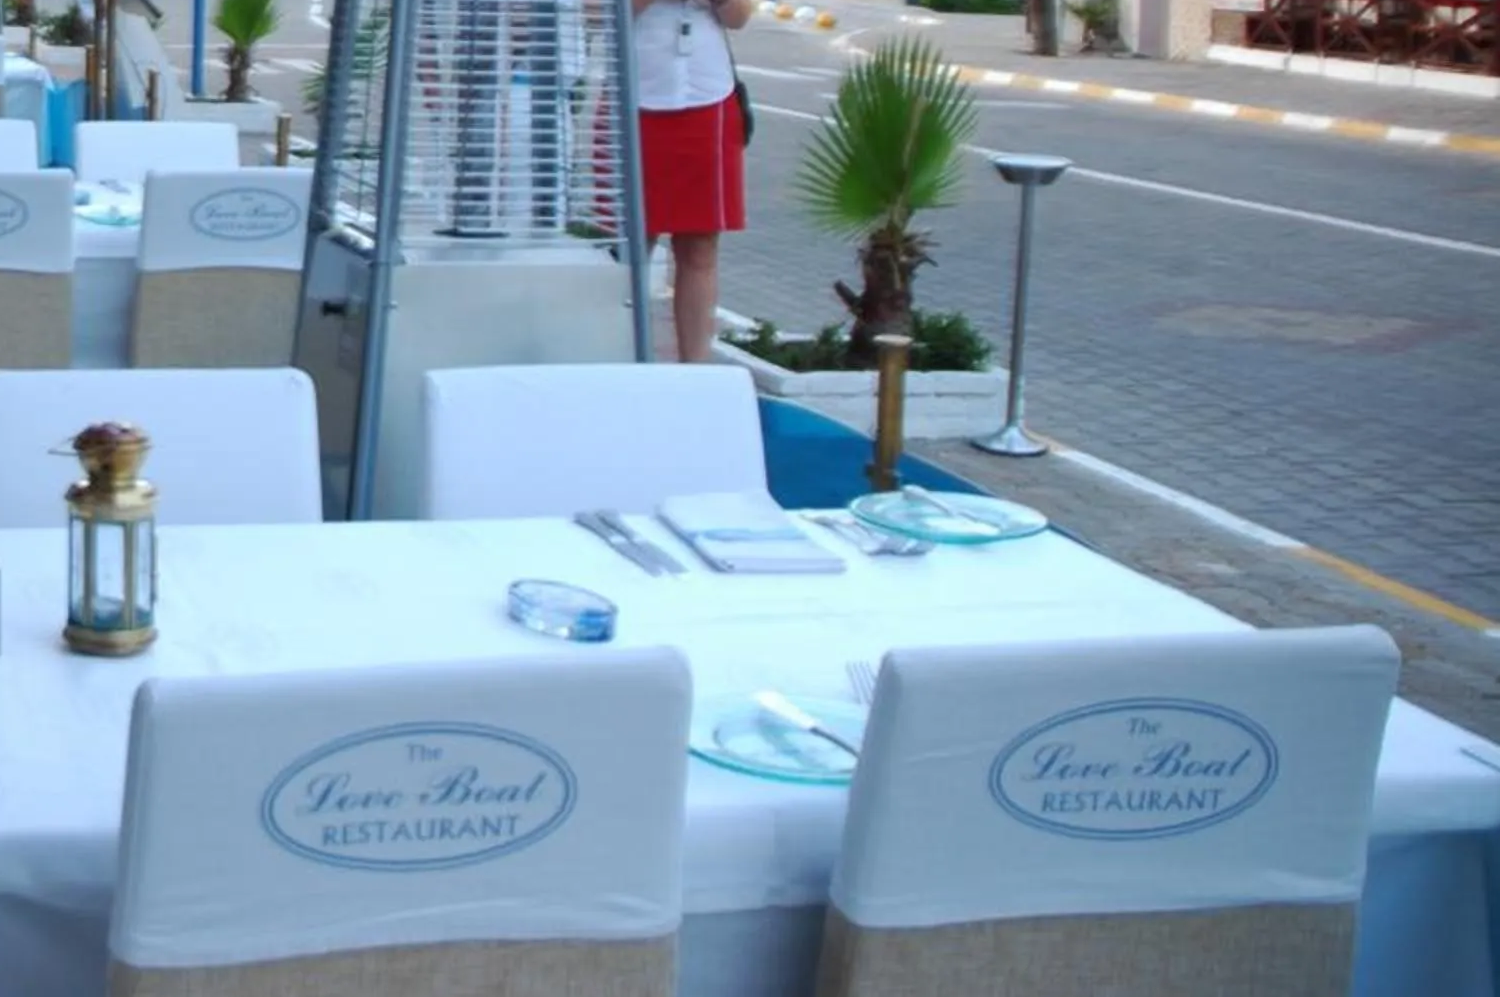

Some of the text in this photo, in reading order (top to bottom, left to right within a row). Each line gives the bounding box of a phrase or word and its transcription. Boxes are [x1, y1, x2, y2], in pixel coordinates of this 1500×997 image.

[1126, 717, 1162, 737] The
[405, 743, 444, 764] The
[1021, 739, 1251, 782] Love Boat
[297, 765, 548, 815] Love Boat
[1041, 787, 1224, 814] RESTAURANT
[321, 812, 522, 847] RESTAURANT
